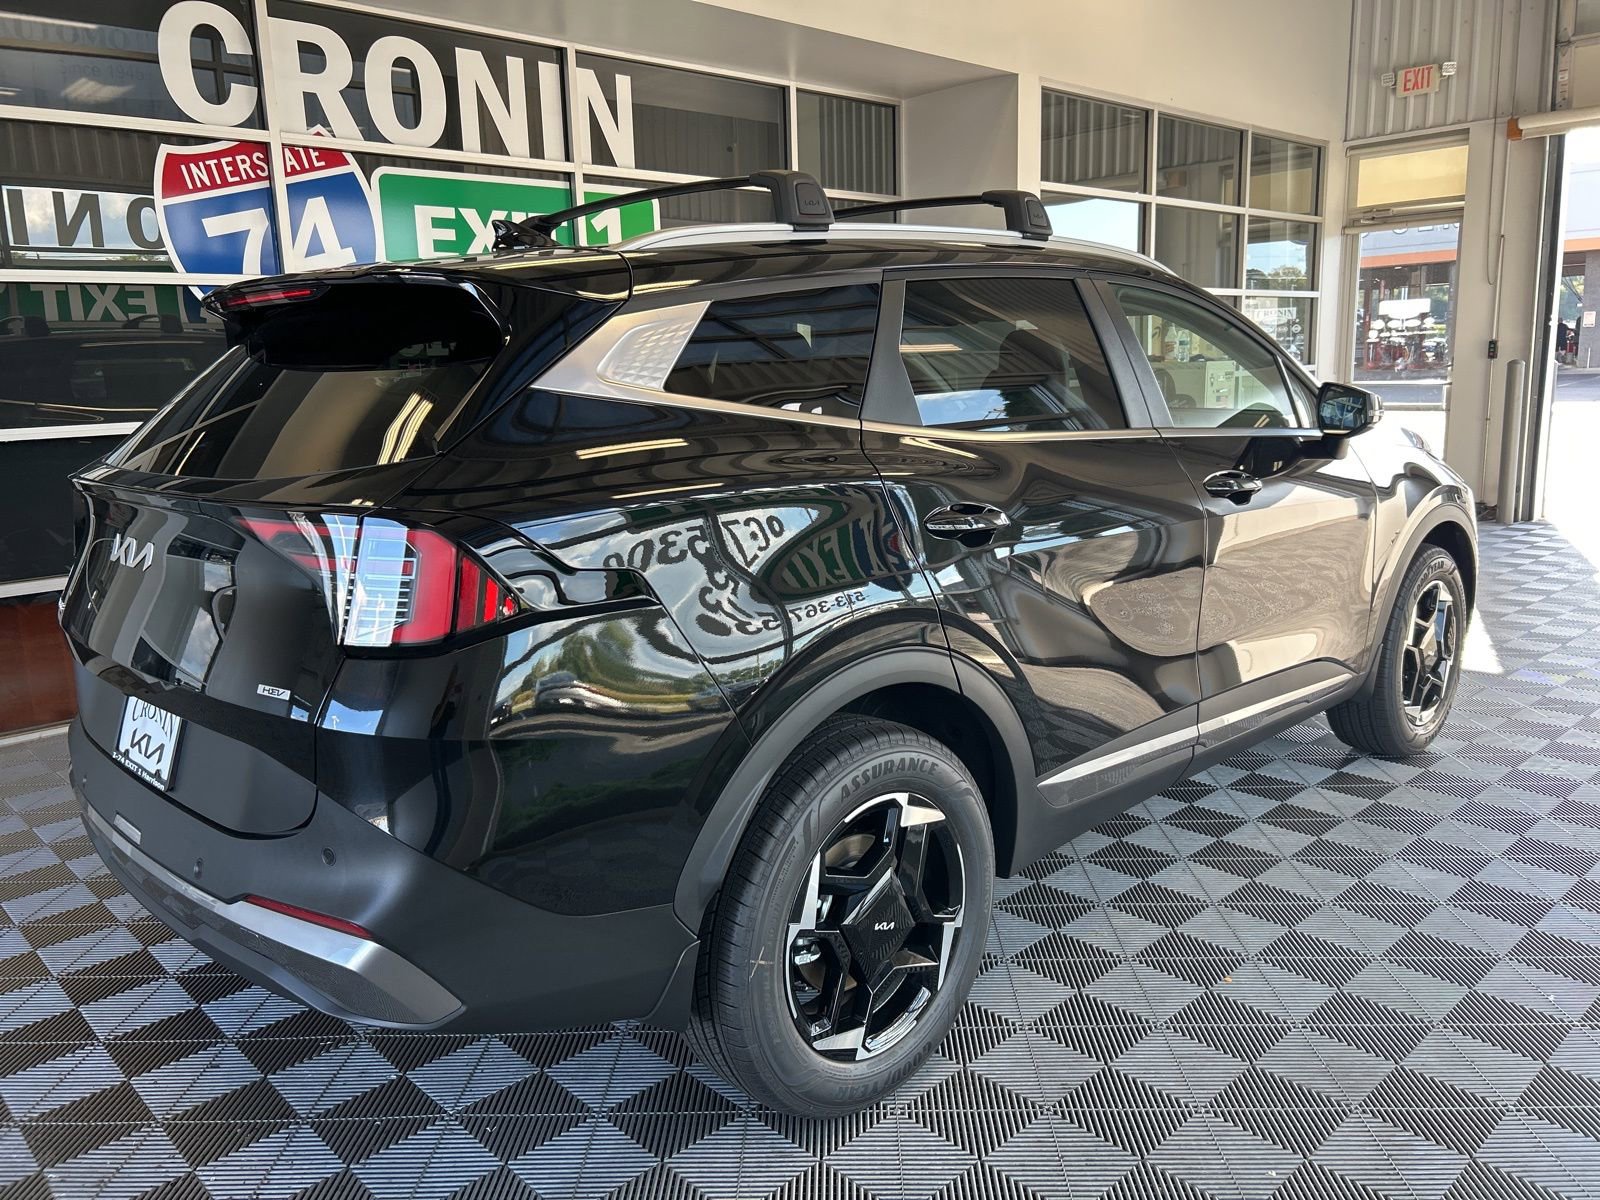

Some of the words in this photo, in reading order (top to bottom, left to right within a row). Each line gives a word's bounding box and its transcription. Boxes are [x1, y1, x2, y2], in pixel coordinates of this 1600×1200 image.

[158, 1, 636, 168] CRONIN
[1403, 67, 1433, 92] EXIT
[180, 147, 326, 190] INTERSATE
[202, 196, 357, 275] 74
[590, 208, 622, 246] 1
[110, 533, 154, 571] KIA
[1413, 560, 1445, 600] GOODYEAR
[132, 699, 175, 742] CRONIN
[130, 728, 165, 765] KIA
[125, 760, 138, 773] EXIT
[141, 771, 166, 791] Harrison
[840, 757, 940, 800] ASSURANCE
[874, 921, 896, 931] KIA
